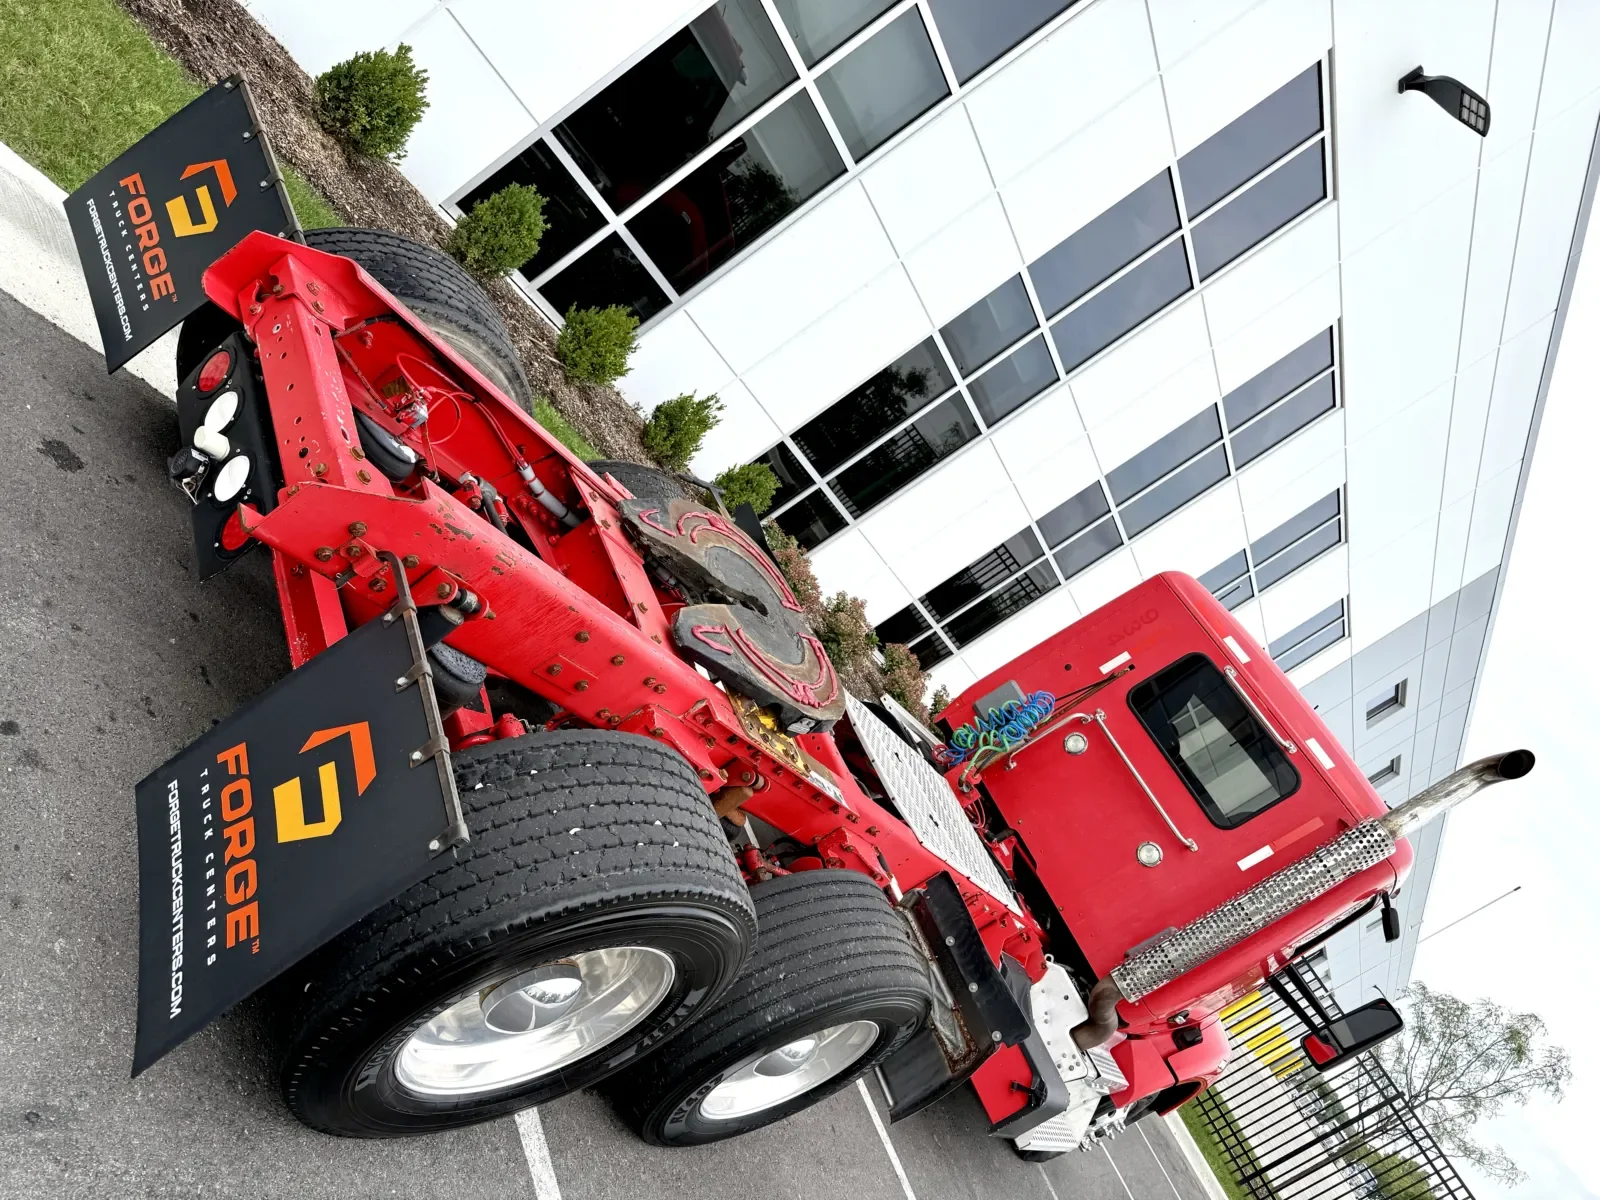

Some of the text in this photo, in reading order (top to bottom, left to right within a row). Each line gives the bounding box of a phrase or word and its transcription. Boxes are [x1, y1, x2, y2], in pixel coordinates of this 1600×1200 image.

[86, 198, 133, 342] FORGETRUCKCENTERS.COM
[108, 190, 150, 312] TRUCK CENTERS
[119, 172, 175, 300] FORGE
[167, 778, 184, 1020] FORGETRUCKCENTERS.COM
[199, 767, 217, 966] TRUCK CENTERS
[216, 742, 260, 949] FORGE
